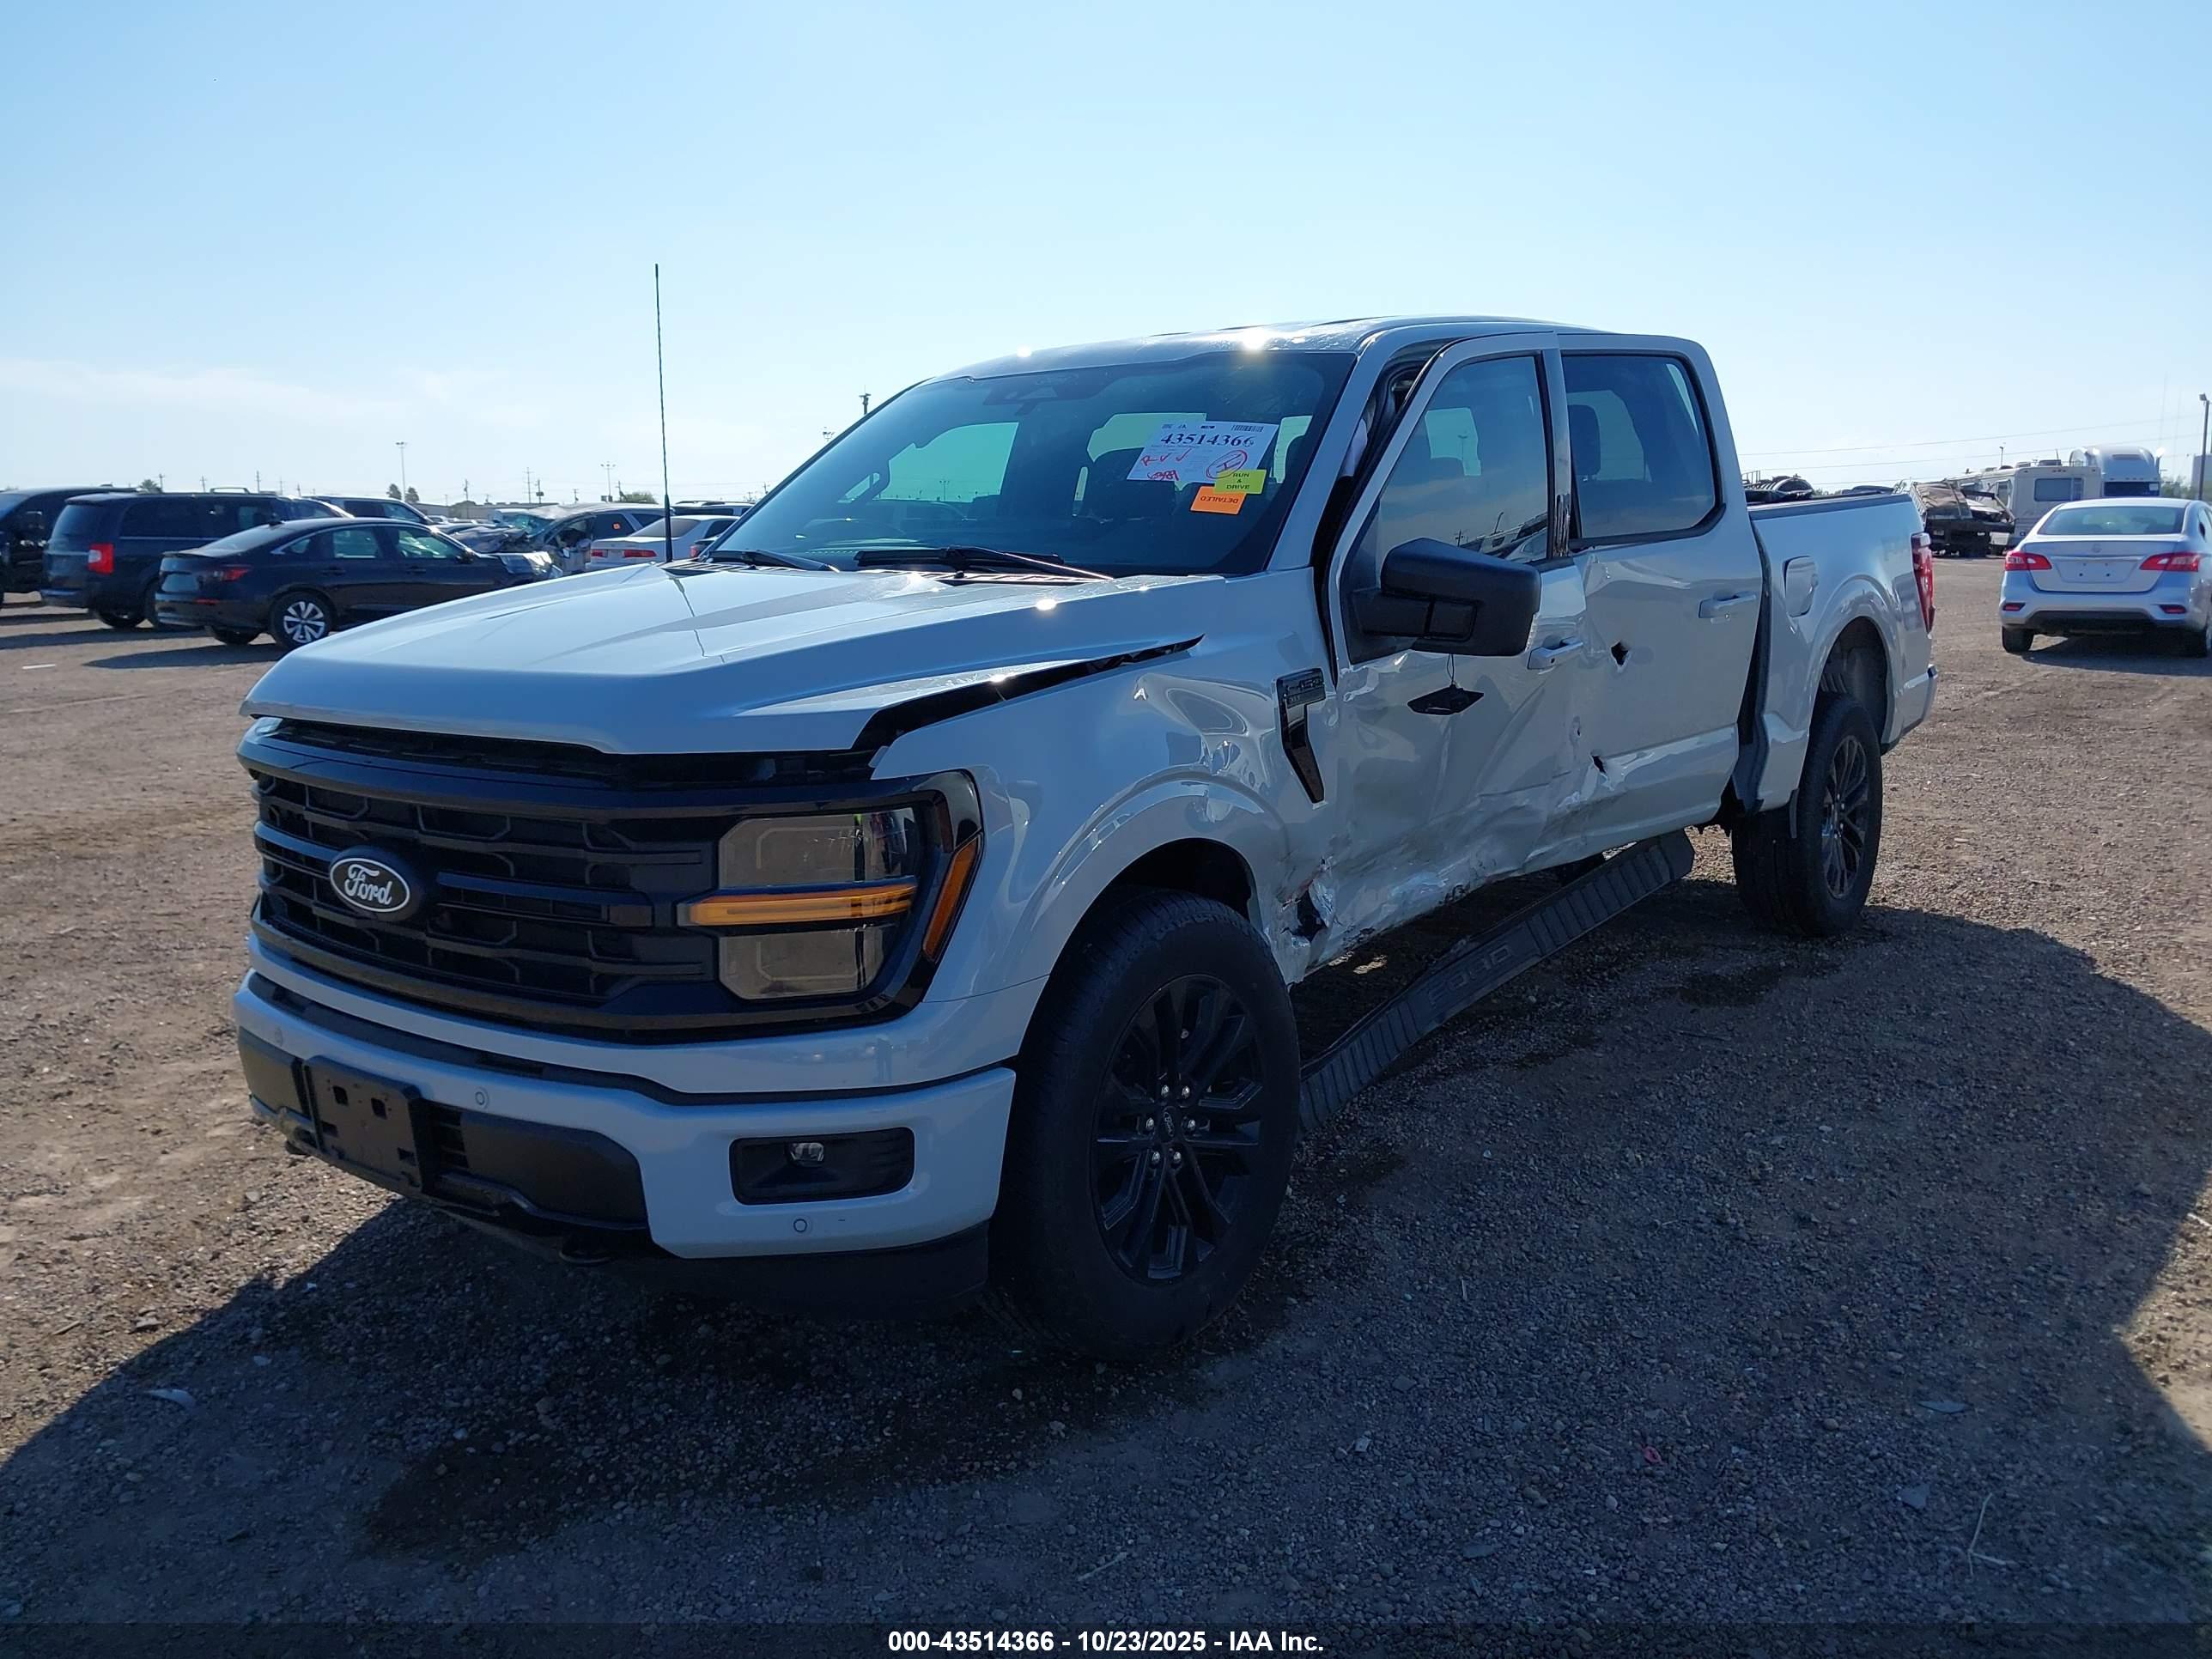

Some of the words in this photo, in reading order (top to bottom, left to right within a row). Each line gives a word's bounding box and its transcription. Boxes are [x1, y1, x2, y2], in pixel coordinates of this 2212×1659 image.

[1160, 433, 1256, 447] 43514366
[1200, 495, 1239, 504] DETAILED
[343, 863, 393, 905] Ford
